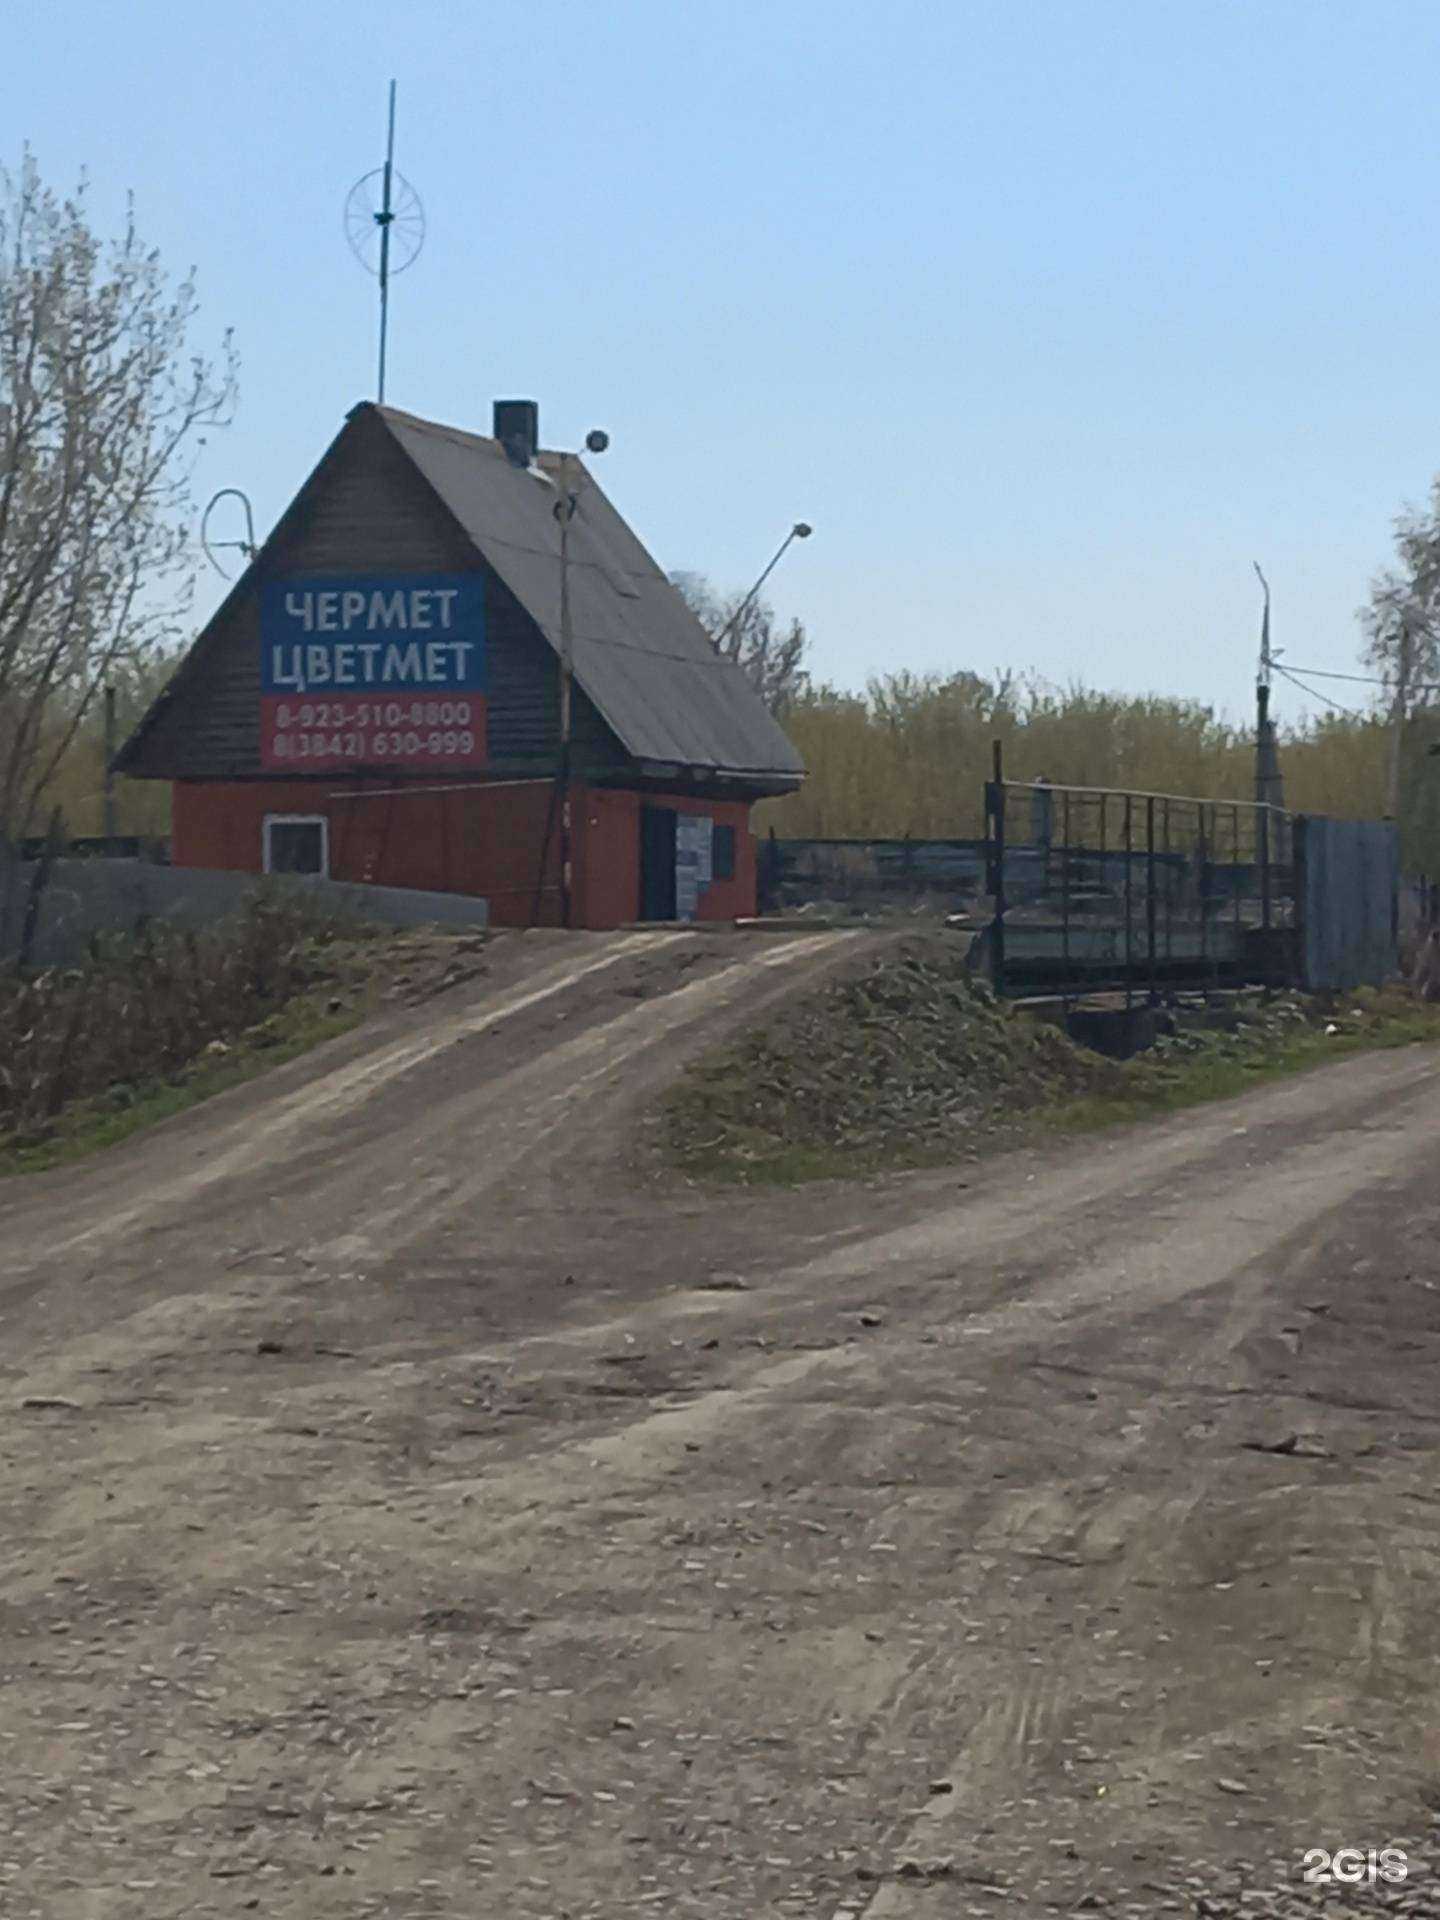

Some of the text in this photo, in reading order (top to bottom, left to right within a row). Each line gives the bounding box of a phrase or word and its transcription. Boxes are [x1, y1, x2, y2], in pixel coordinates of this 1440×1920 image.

[285, 590, 458, 631] ЧЕРМЕТ
[272, 642, 474, 693] ЦВЕТМЕТ
[273, 730, 475, 759] 8(3842) 630-999
